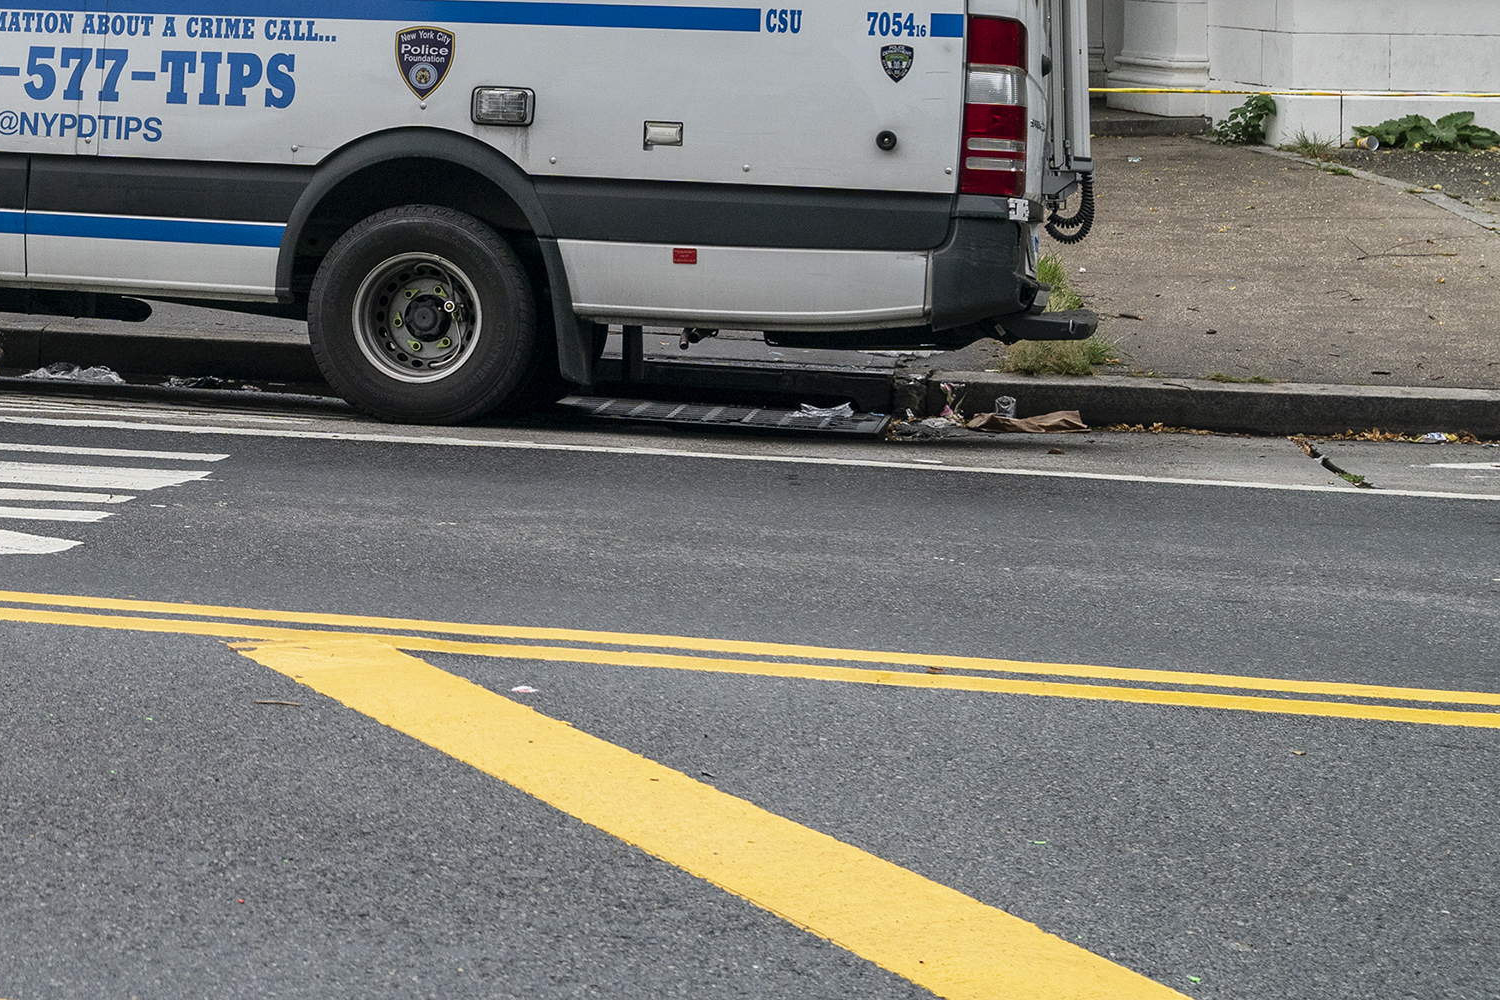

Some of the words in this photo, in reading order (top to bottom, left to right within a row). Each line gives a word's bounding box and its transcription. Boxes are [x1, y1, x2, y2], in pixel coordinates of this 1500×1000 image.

[83, 14, 155, 37] ABOUT
[162, 17, 177, 37] A
[186, 17, 255, 39] CRIME
[264, 19, 338, 43] CALL...
[766, 8, 803, 35] CSU
[401, 32, 417, 43] New
[419, 30, 435, 40] York
[436, 31, 451, 46] City
[401, 43, 449, 56] Police
[404, 53, 445, 63] Foundation
